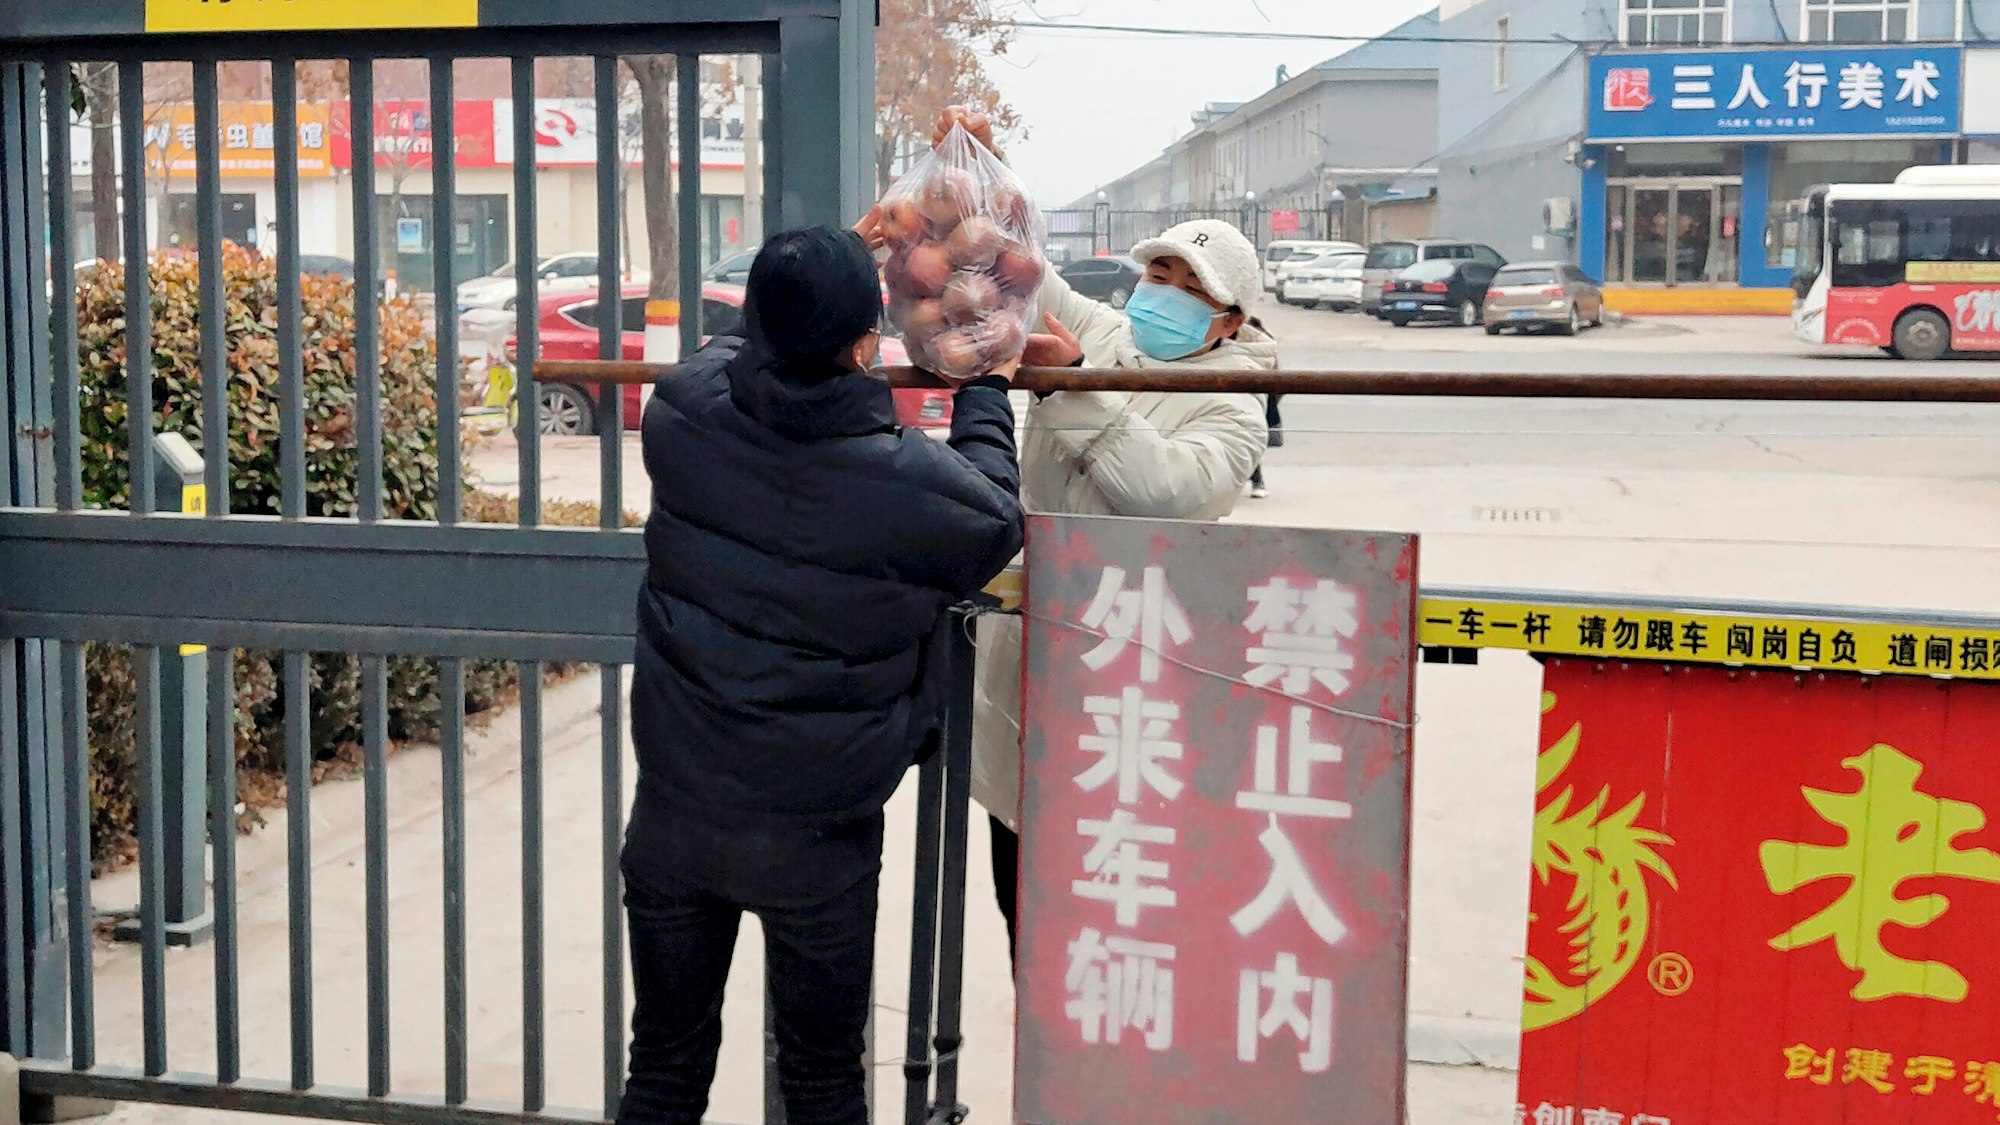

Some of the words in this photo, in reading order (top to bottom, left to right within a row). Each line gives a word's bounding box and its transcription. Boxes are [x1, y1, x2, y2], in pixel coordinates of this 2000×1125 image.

[1671, 59, 1941, 110] 三人行美术
[1190, 233, 1209, 247] R
[1425, 607, 1552, 645] 一车一杆
[1577, 615, 1708, 655] 请勿跟车
[1727, 623, 1857, 664] 闯岗自负
[1065, 565, 1194, 1051] 外来车辆
[1229, 576, 1358, 1072] 禁止入内
[1759, 743, 2000, 1001] 老
